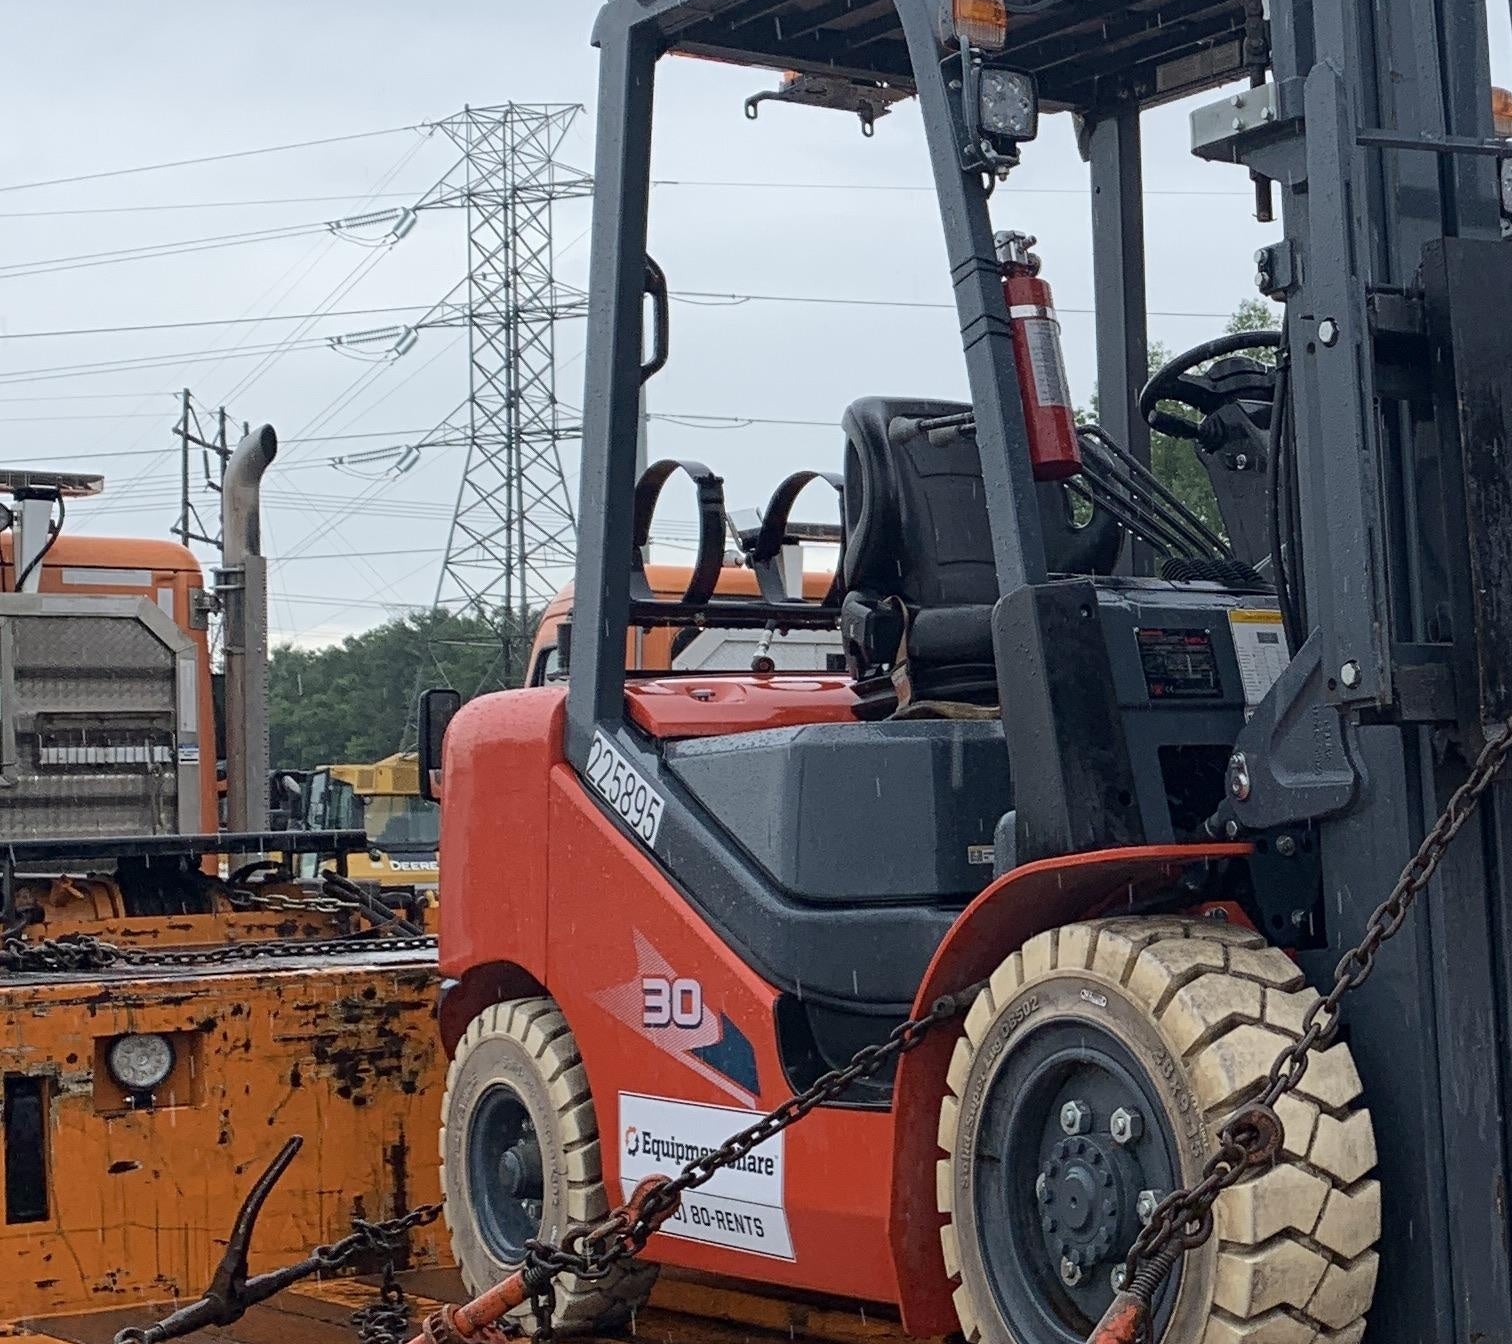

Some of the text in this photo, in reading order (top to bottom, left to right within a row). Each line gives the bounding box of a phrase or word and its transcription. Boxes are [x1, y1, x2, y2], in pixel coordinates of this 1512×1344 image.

[586, 736, 661, 842] 225895
[390, 860, 439, 871] DEERE
[642, 977, 703, 1029] 30
[690, 1205, 765, 1238] 80-RENTS
